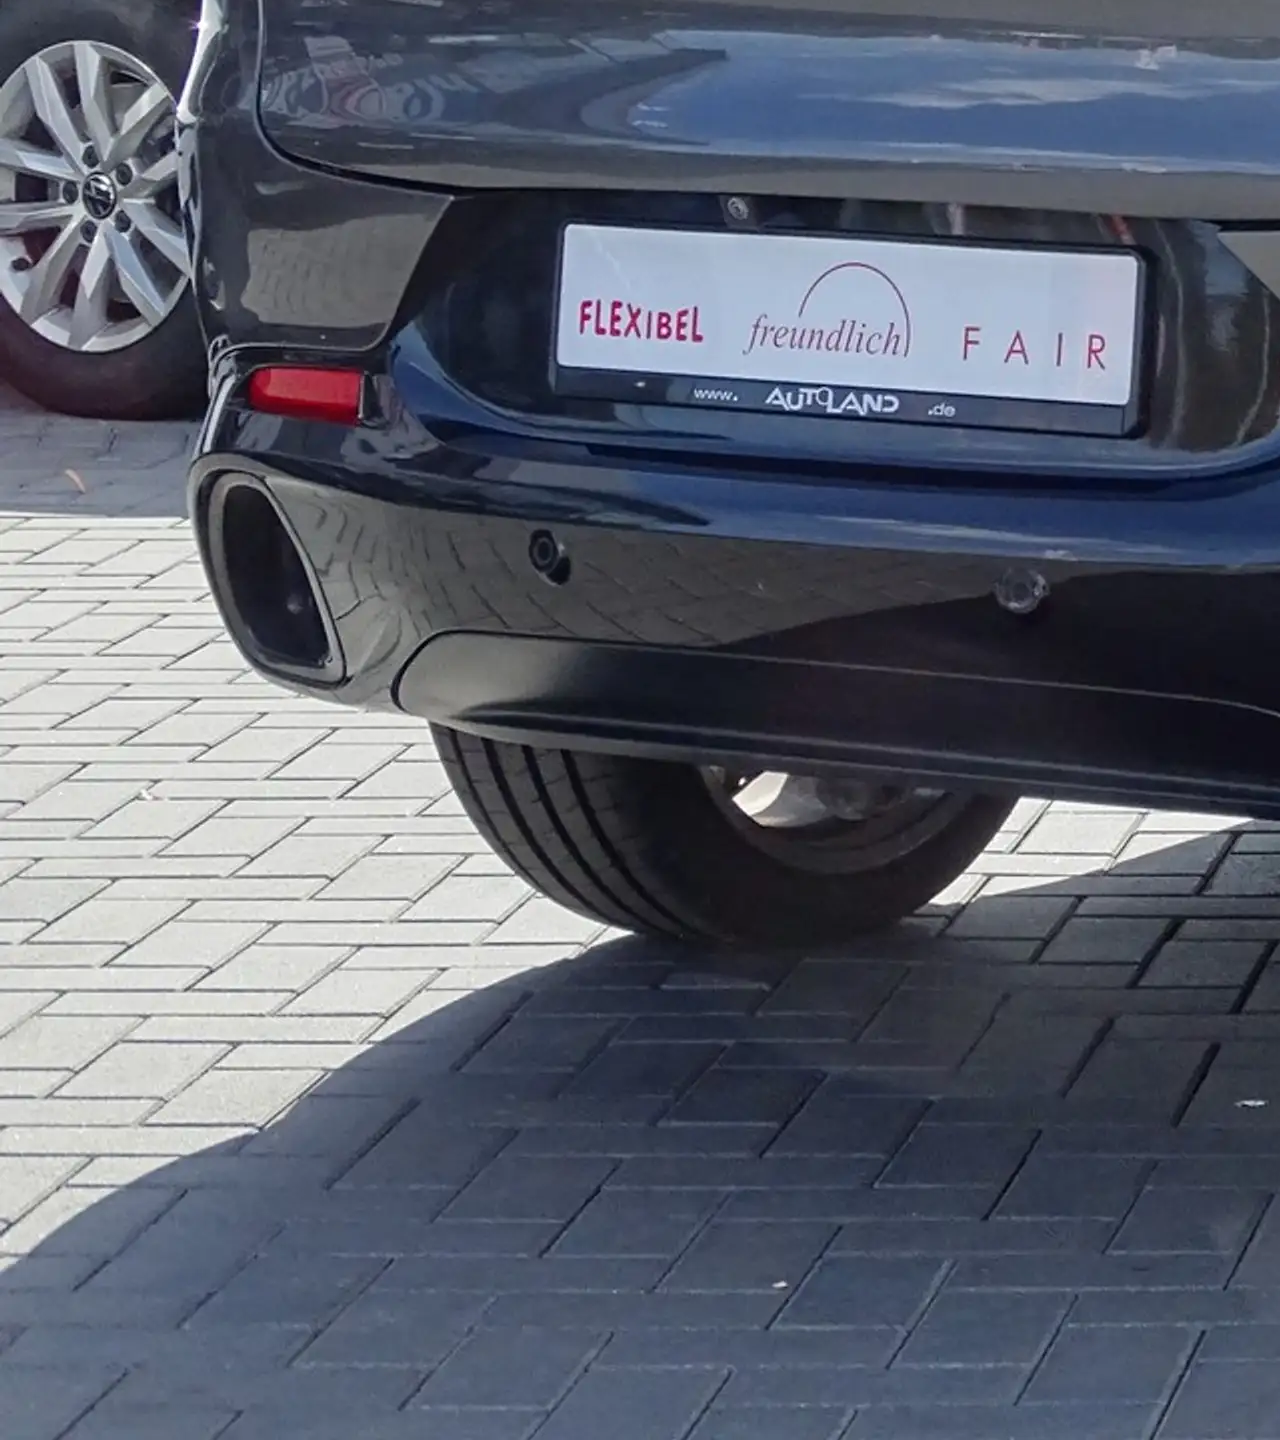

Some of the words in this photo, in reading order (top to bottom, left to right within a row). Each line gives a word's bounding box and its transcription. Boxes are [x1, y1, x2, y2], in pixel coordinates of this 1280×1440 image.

[579, 298, 704, 343] FLEXIBEL
[742, 313, 901, 357] freundlich
[962, 326, 1107, 371] FAIR
[693, 387, 739, 403] www.
[764, 386, 900, 417] AUTOLAND
